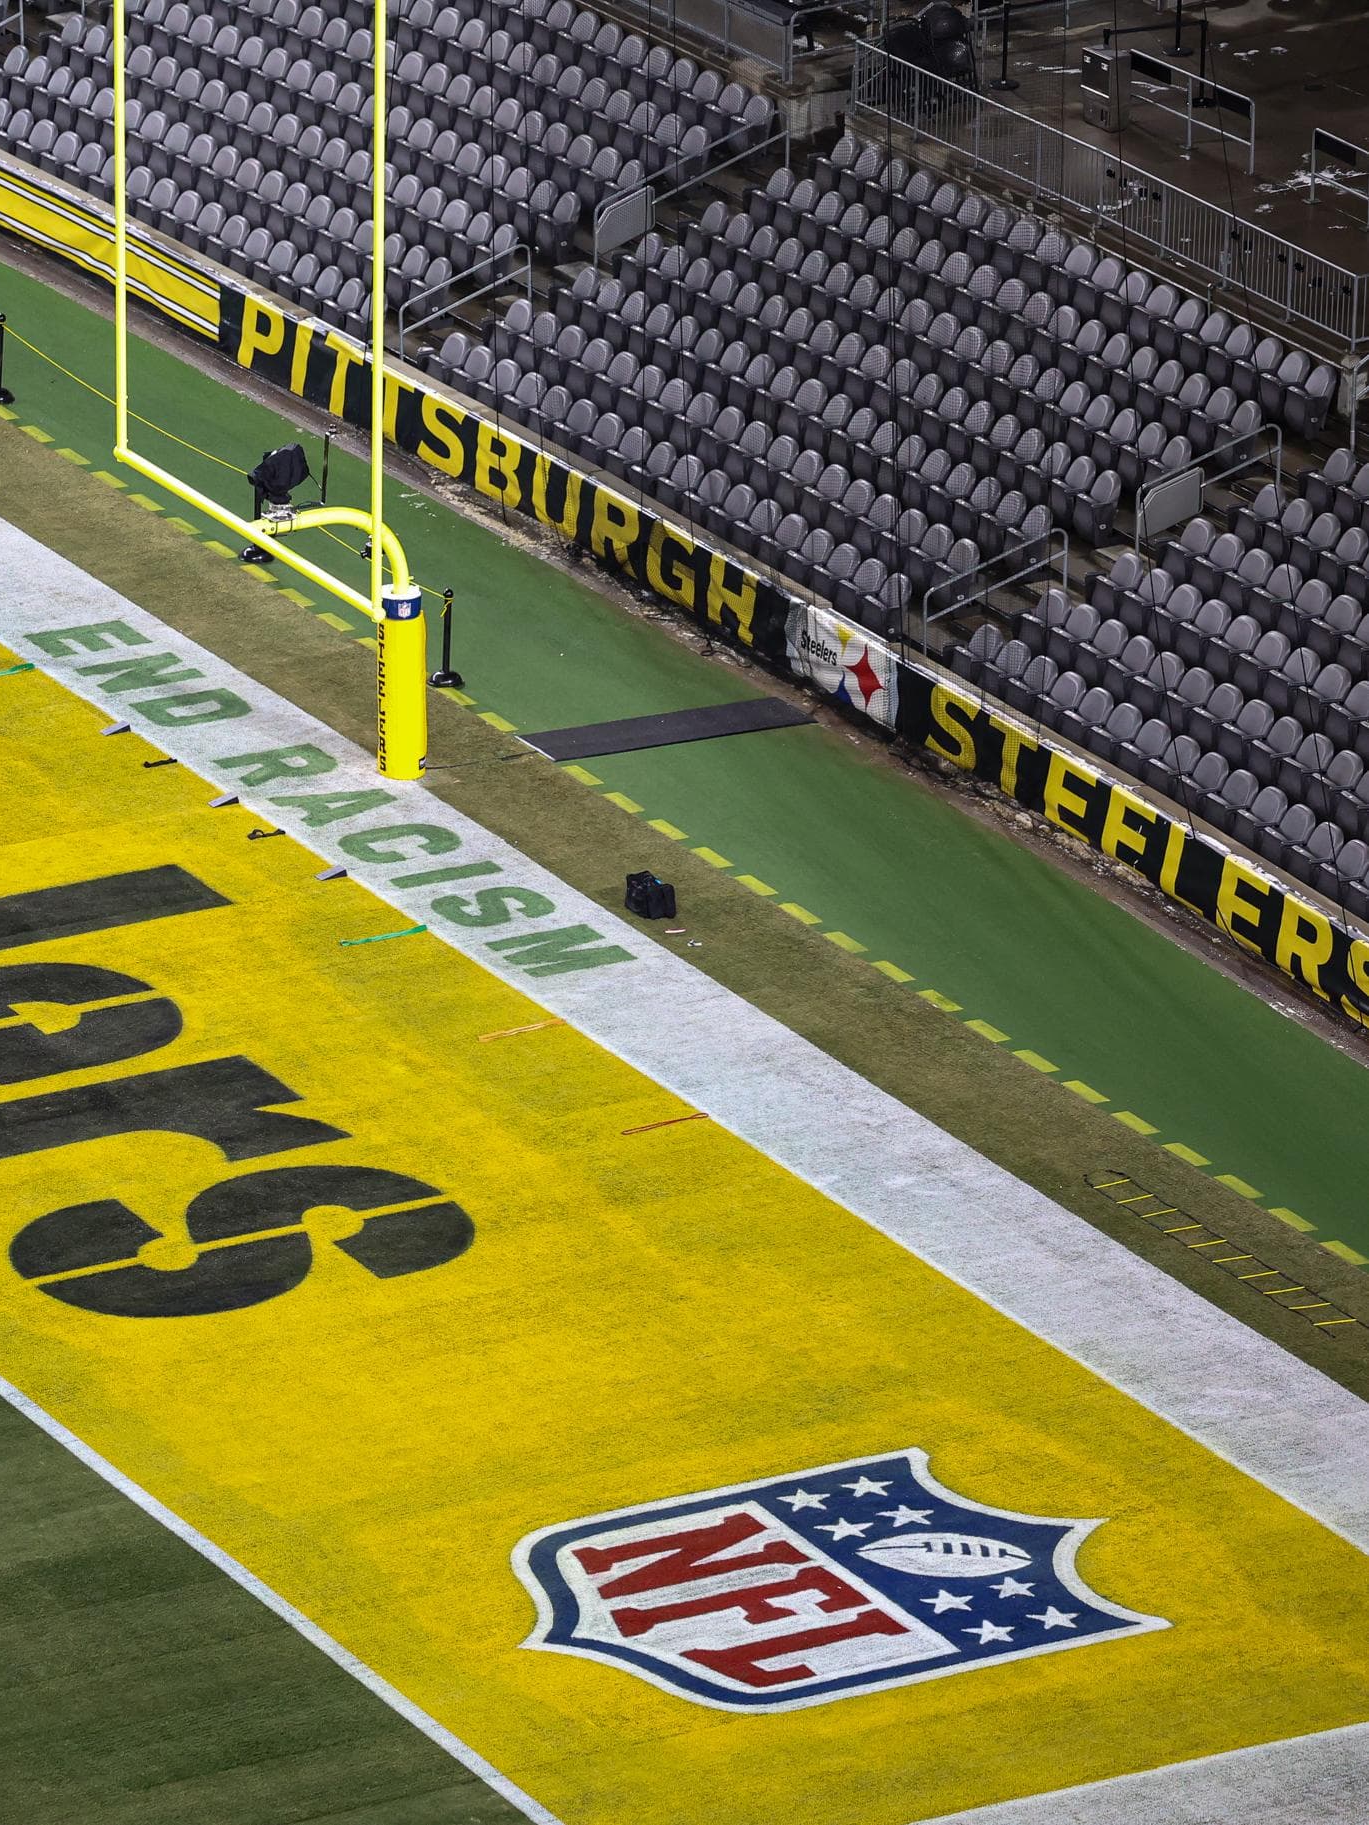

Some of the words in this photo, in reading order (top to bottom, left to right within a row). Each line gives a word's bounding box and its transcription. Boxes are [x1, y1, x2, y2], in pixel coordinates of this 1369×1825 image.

[236, 294, 760, 648] PITTSBURGH
[377, 623, 387, 772] STEELERS
[800, 629, 838, 666] Steelers
[23, 619, 253, 729] END
[211, 741, 639, 978] RACISM
[573, 1511, 912, 1689] NFL
